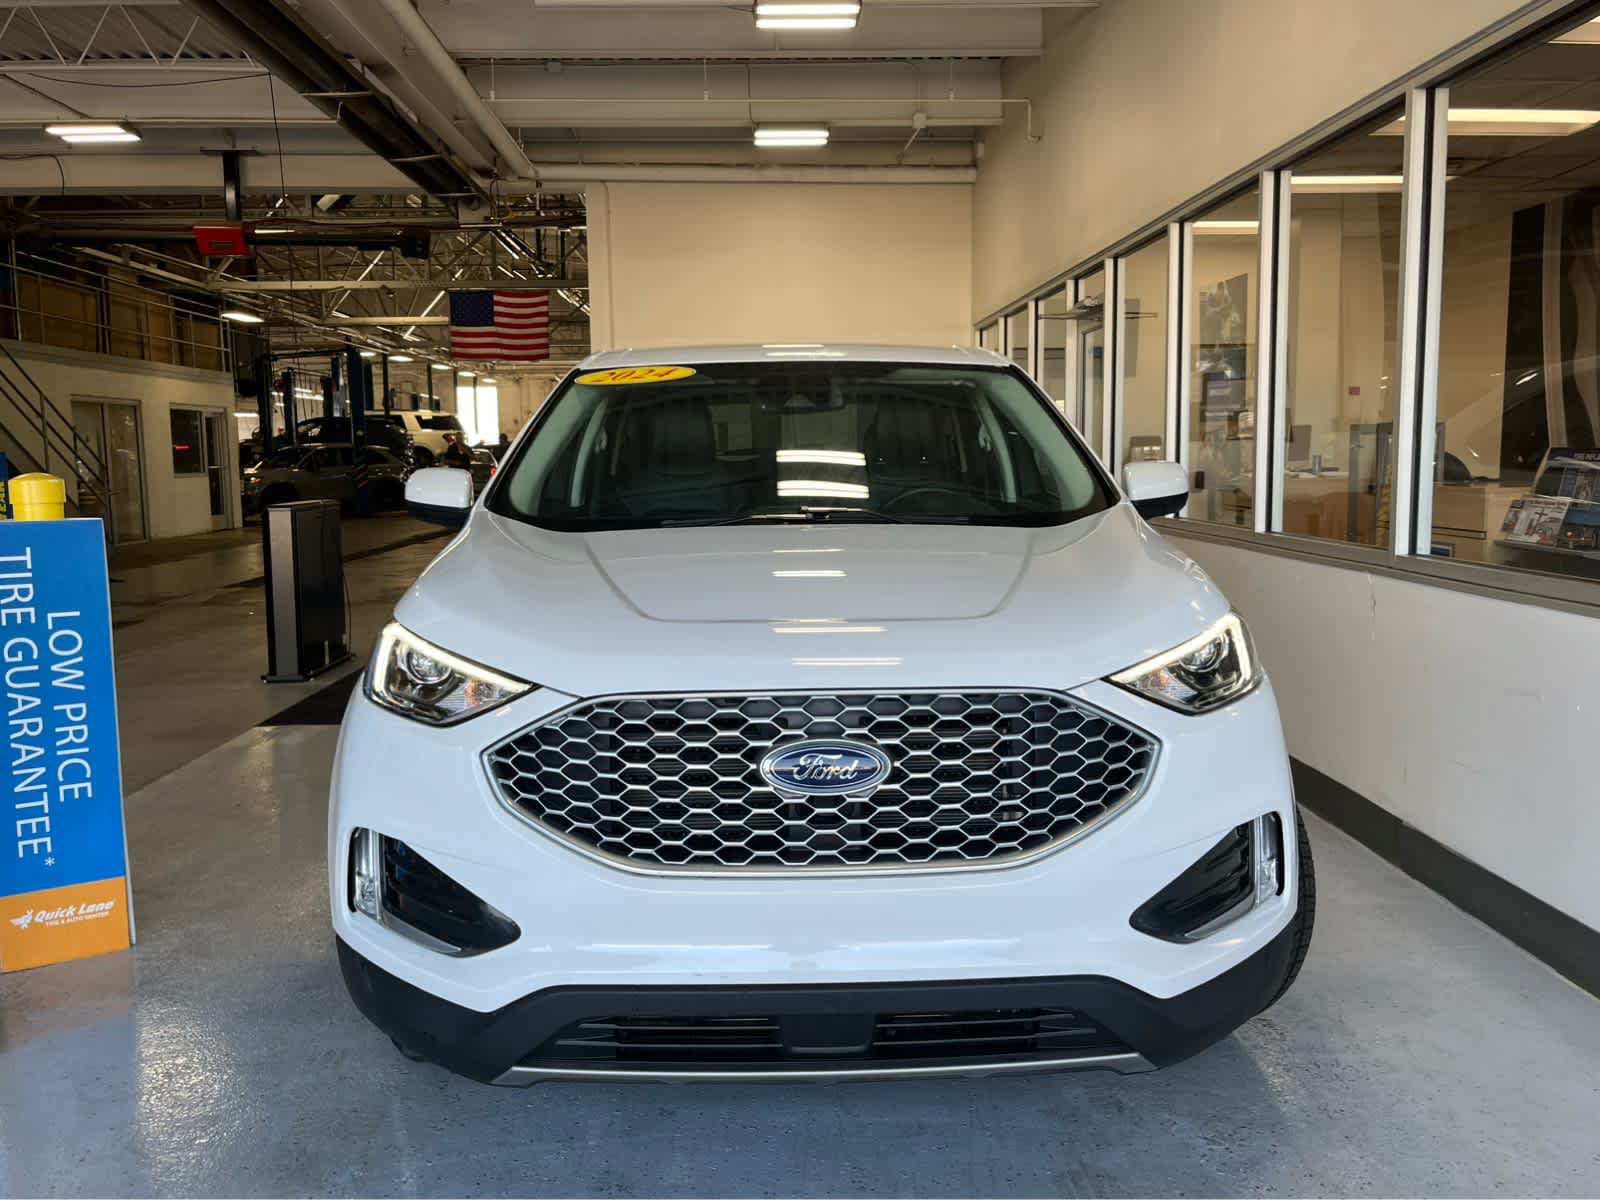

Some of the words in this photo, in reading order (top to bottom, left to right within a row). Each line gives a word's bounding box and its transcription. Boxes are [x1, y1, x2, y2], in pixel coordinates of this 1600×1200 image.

[590, 367, 678, 382] 2024
[0, 547, 36, 626] TIRE
[48, 611, 86, 690] LOW
[53, 703, 92, 802] PRICE
[792, 753, 859, 780] Ford
[35, 905, 76, 923] Quick
[79, 901, 115, 915] Lane
